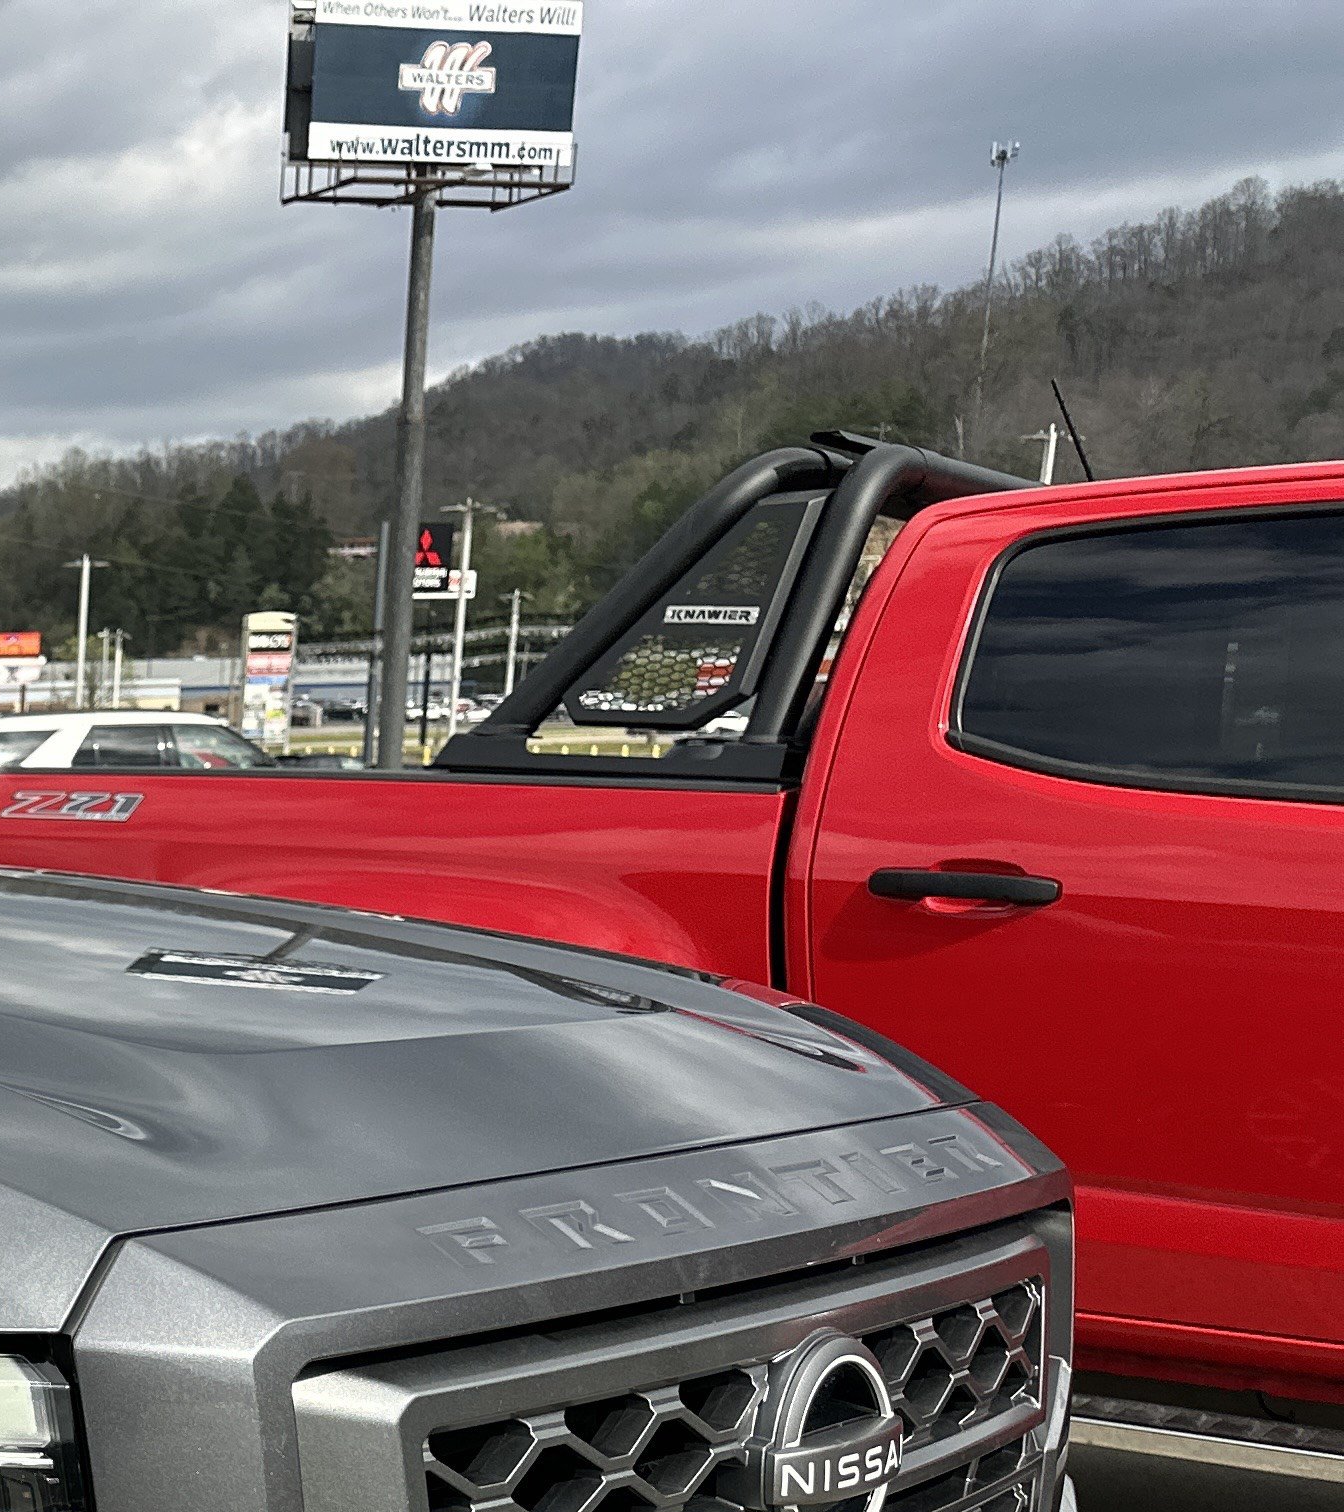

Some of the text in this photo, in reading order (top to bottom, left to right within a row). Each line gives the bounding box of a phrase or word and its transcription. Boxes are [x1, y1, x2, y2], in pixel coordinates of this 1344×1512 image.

[322, 1, 360, 15] When
[364, 2, 407, 19] Others
[468, 4, 535, 24] Walters
[539, 6, 577, 26] Will!
[411, 69, 486, 87] WALTERS
[329, 132, 554, 161] www.waltersmm.com
[670, 609, 752, 622] KNAWIER
[0, 789, 145, 822] Z71
[413, 1133, 1003, 1269] FRONTIER
